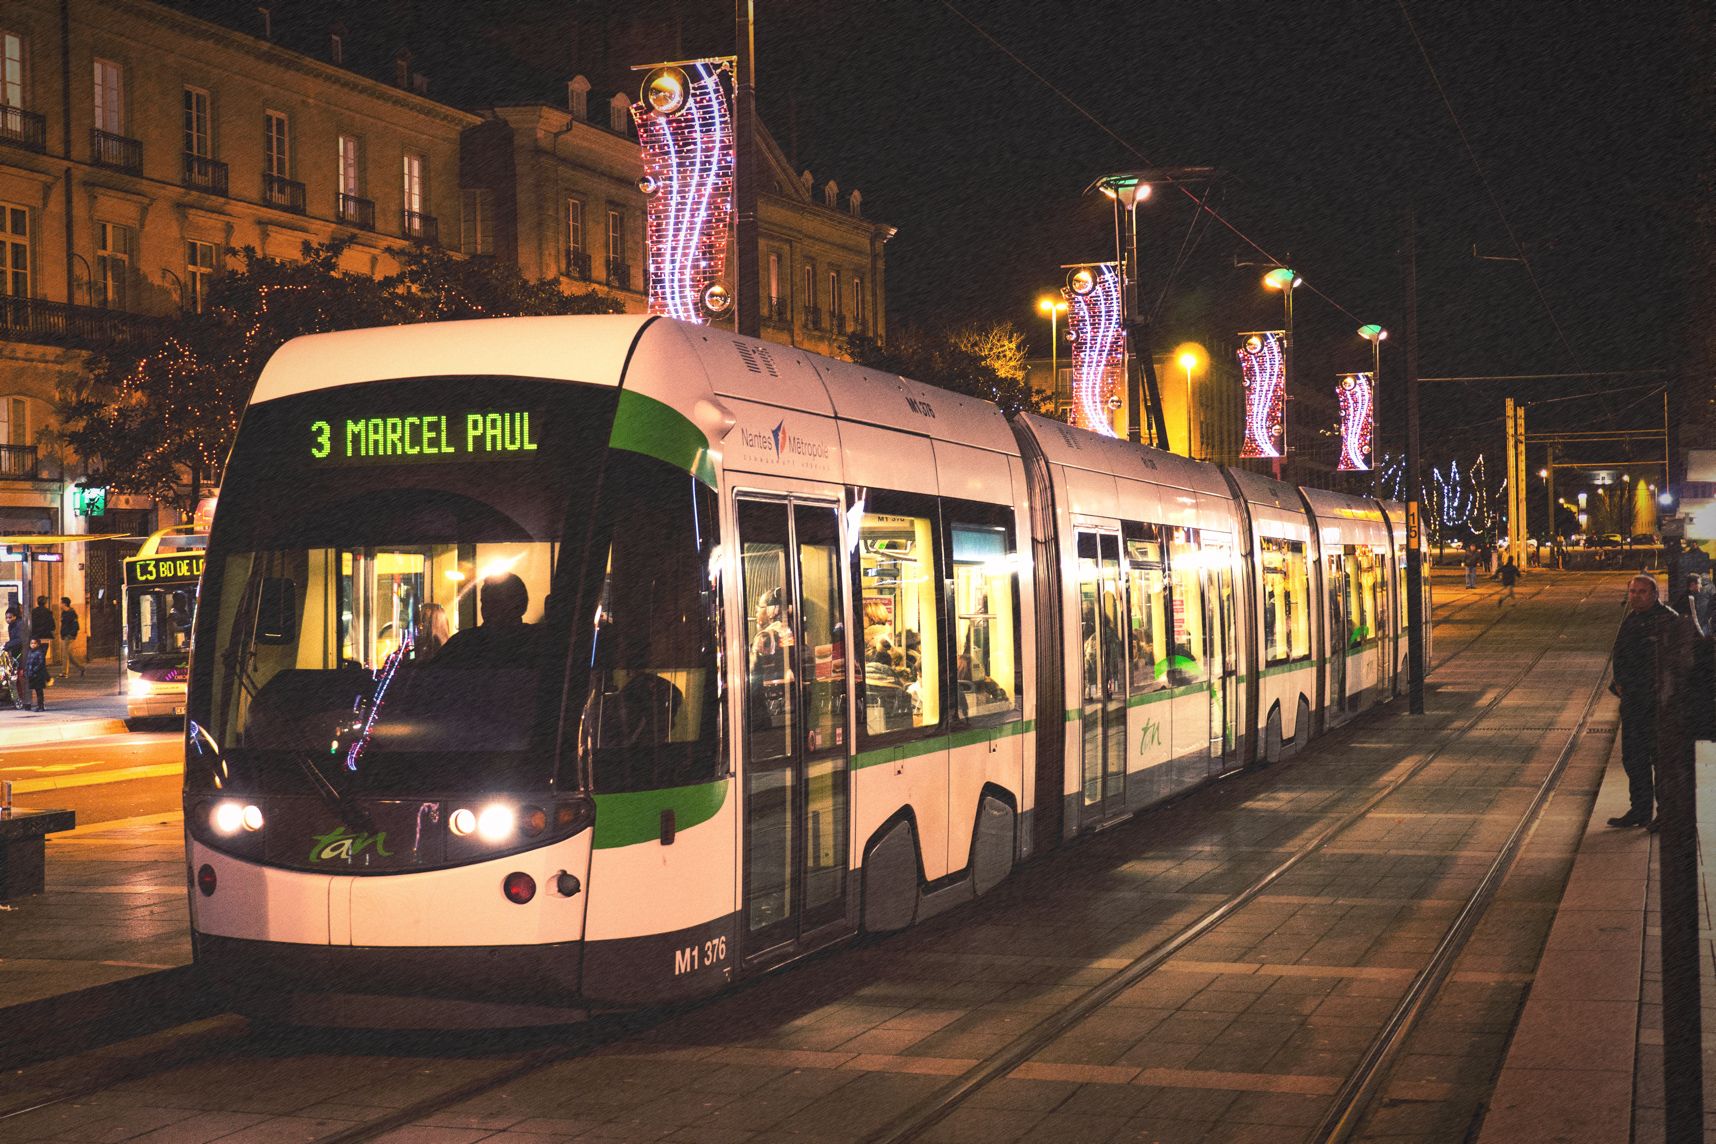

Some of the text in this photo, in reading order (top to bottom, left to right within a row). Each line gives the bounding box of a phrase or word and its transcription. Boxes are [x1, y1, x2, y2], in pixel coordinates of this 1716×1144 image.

[311, 412, 538, 458] 3 MARCEL PAUL
[741, 427, 829, 461] Nantes Métropole
[136, 560, 157, 581] C3
[159, 561, 175, 578] BD
[176, 559, 191, 577] DE
[309, 826, 394, 864] tan
[674, 935, 727, 976] M1 376
